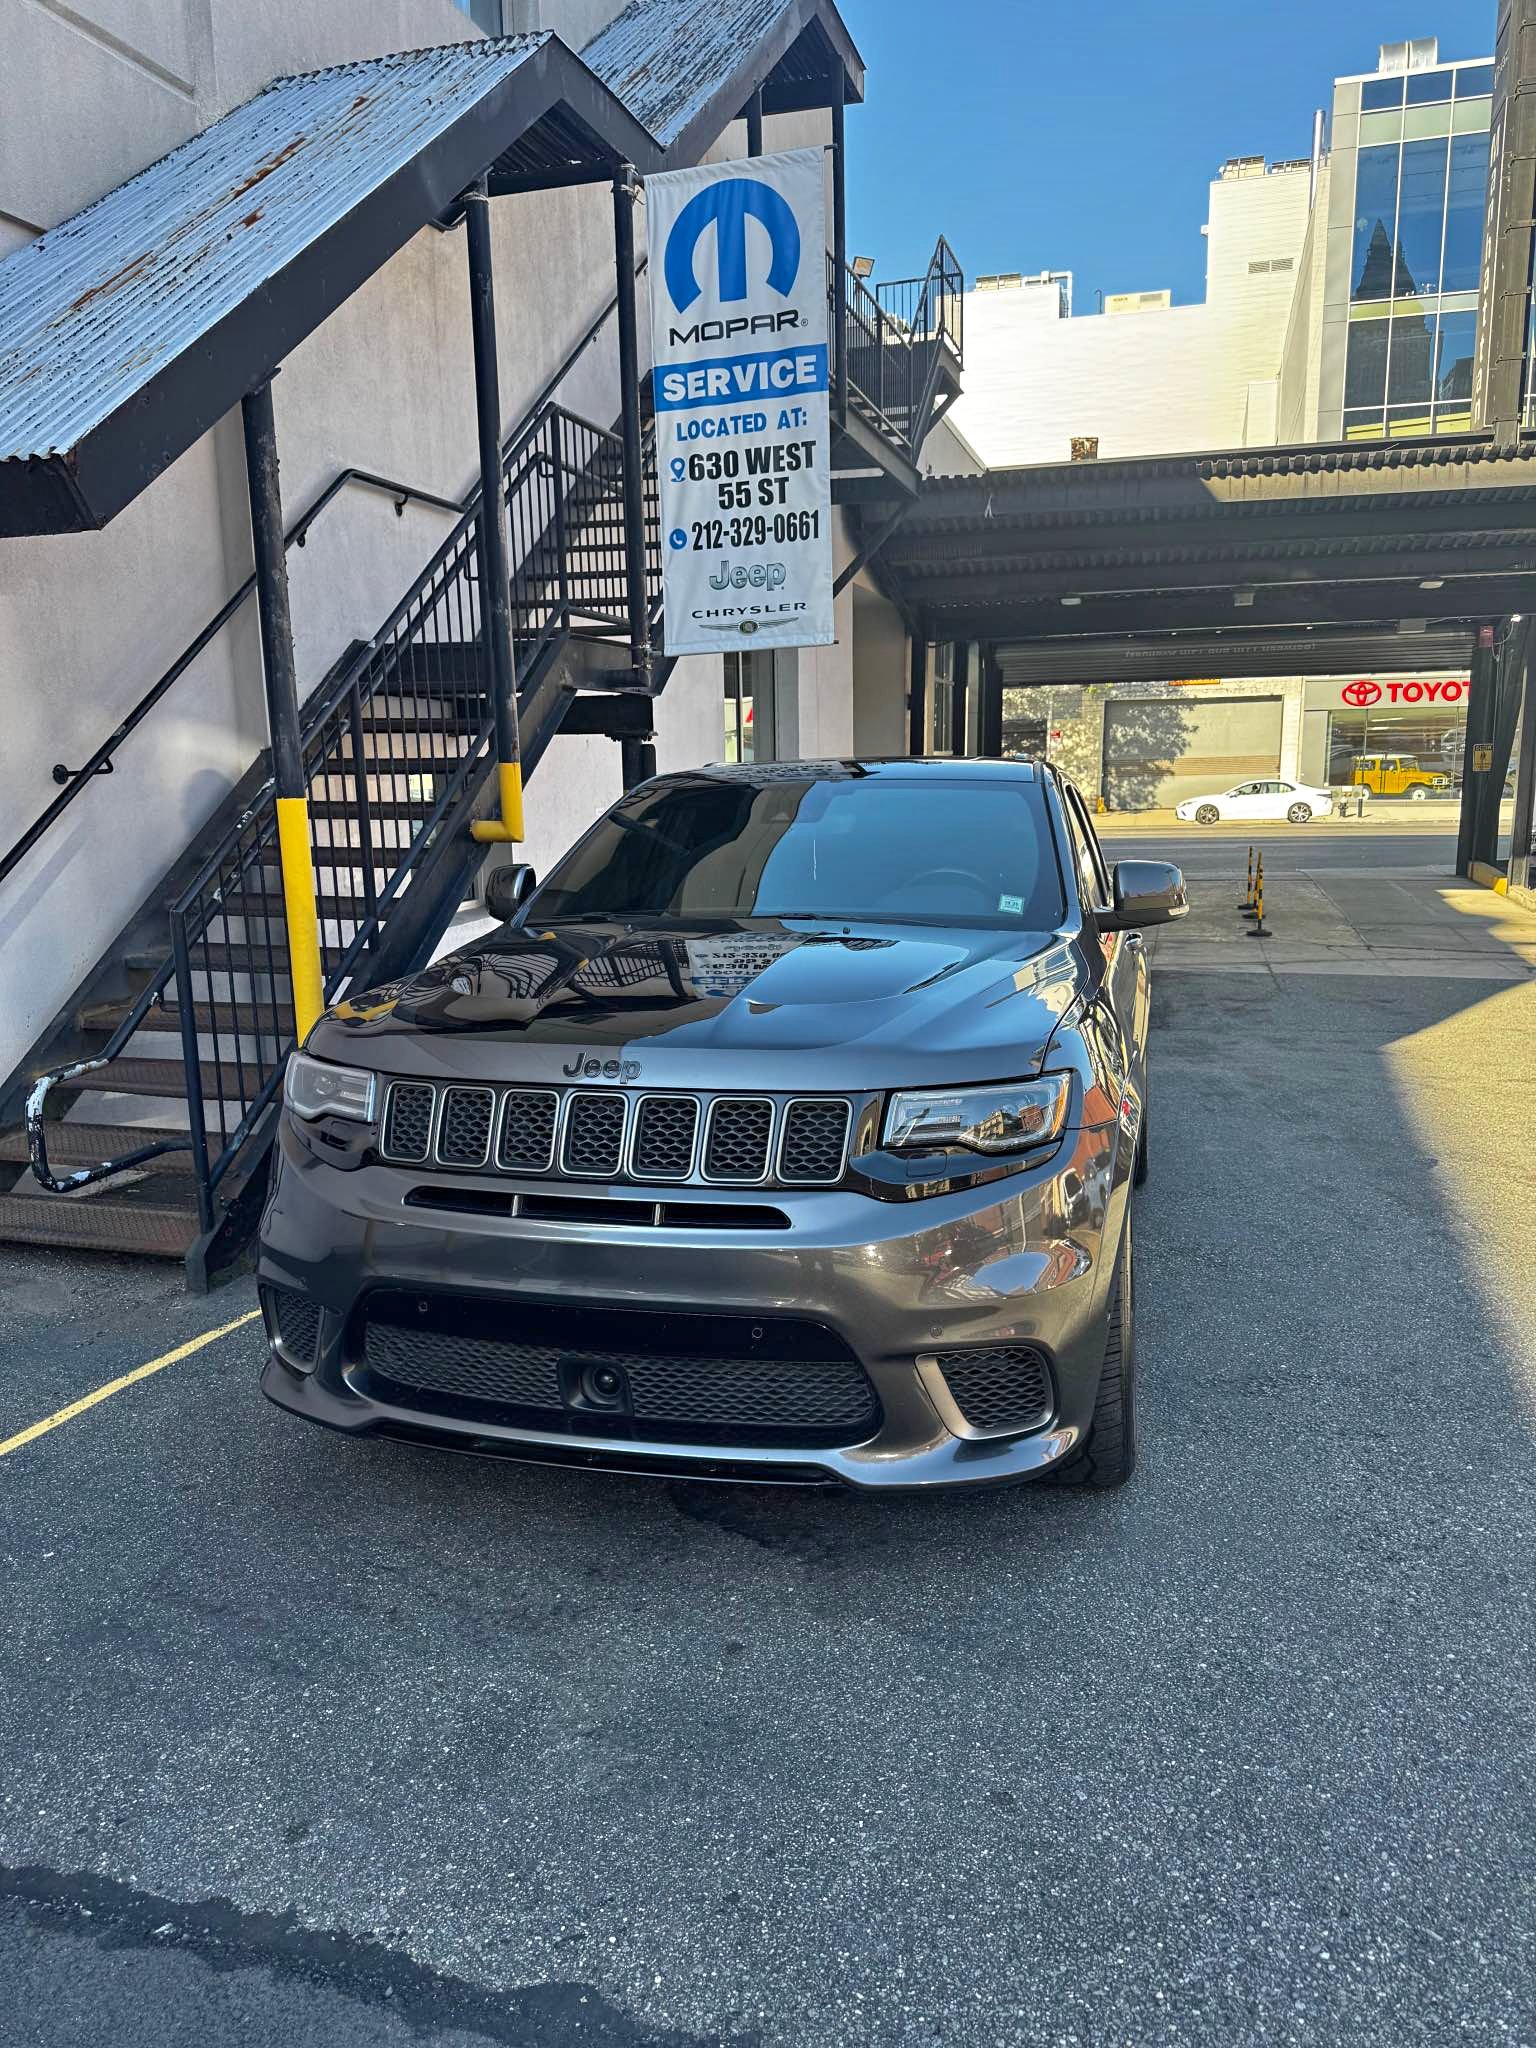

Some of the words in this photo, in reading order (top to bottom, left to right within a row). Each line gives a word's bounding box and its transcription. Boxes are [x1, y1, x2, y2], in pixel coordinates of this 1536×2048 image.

[663, 354, 817, 402] SERVICE
[676, 412, 767, 442] LOCATED
[777, 407, 808, 430] AT:
[688, 449, 739, 482] 630
[745, 440, 817, 475] WEST
[718, 480, 751, 510] 55
[758, 476, 790, 506] ST
[691, 509, 820, 551] 212-329-0661
[709, 560, 787, 592] Jeep
[691, 602, 808, 619] CHRYSLER
[562, 1052, 642, 1085] Jeep
